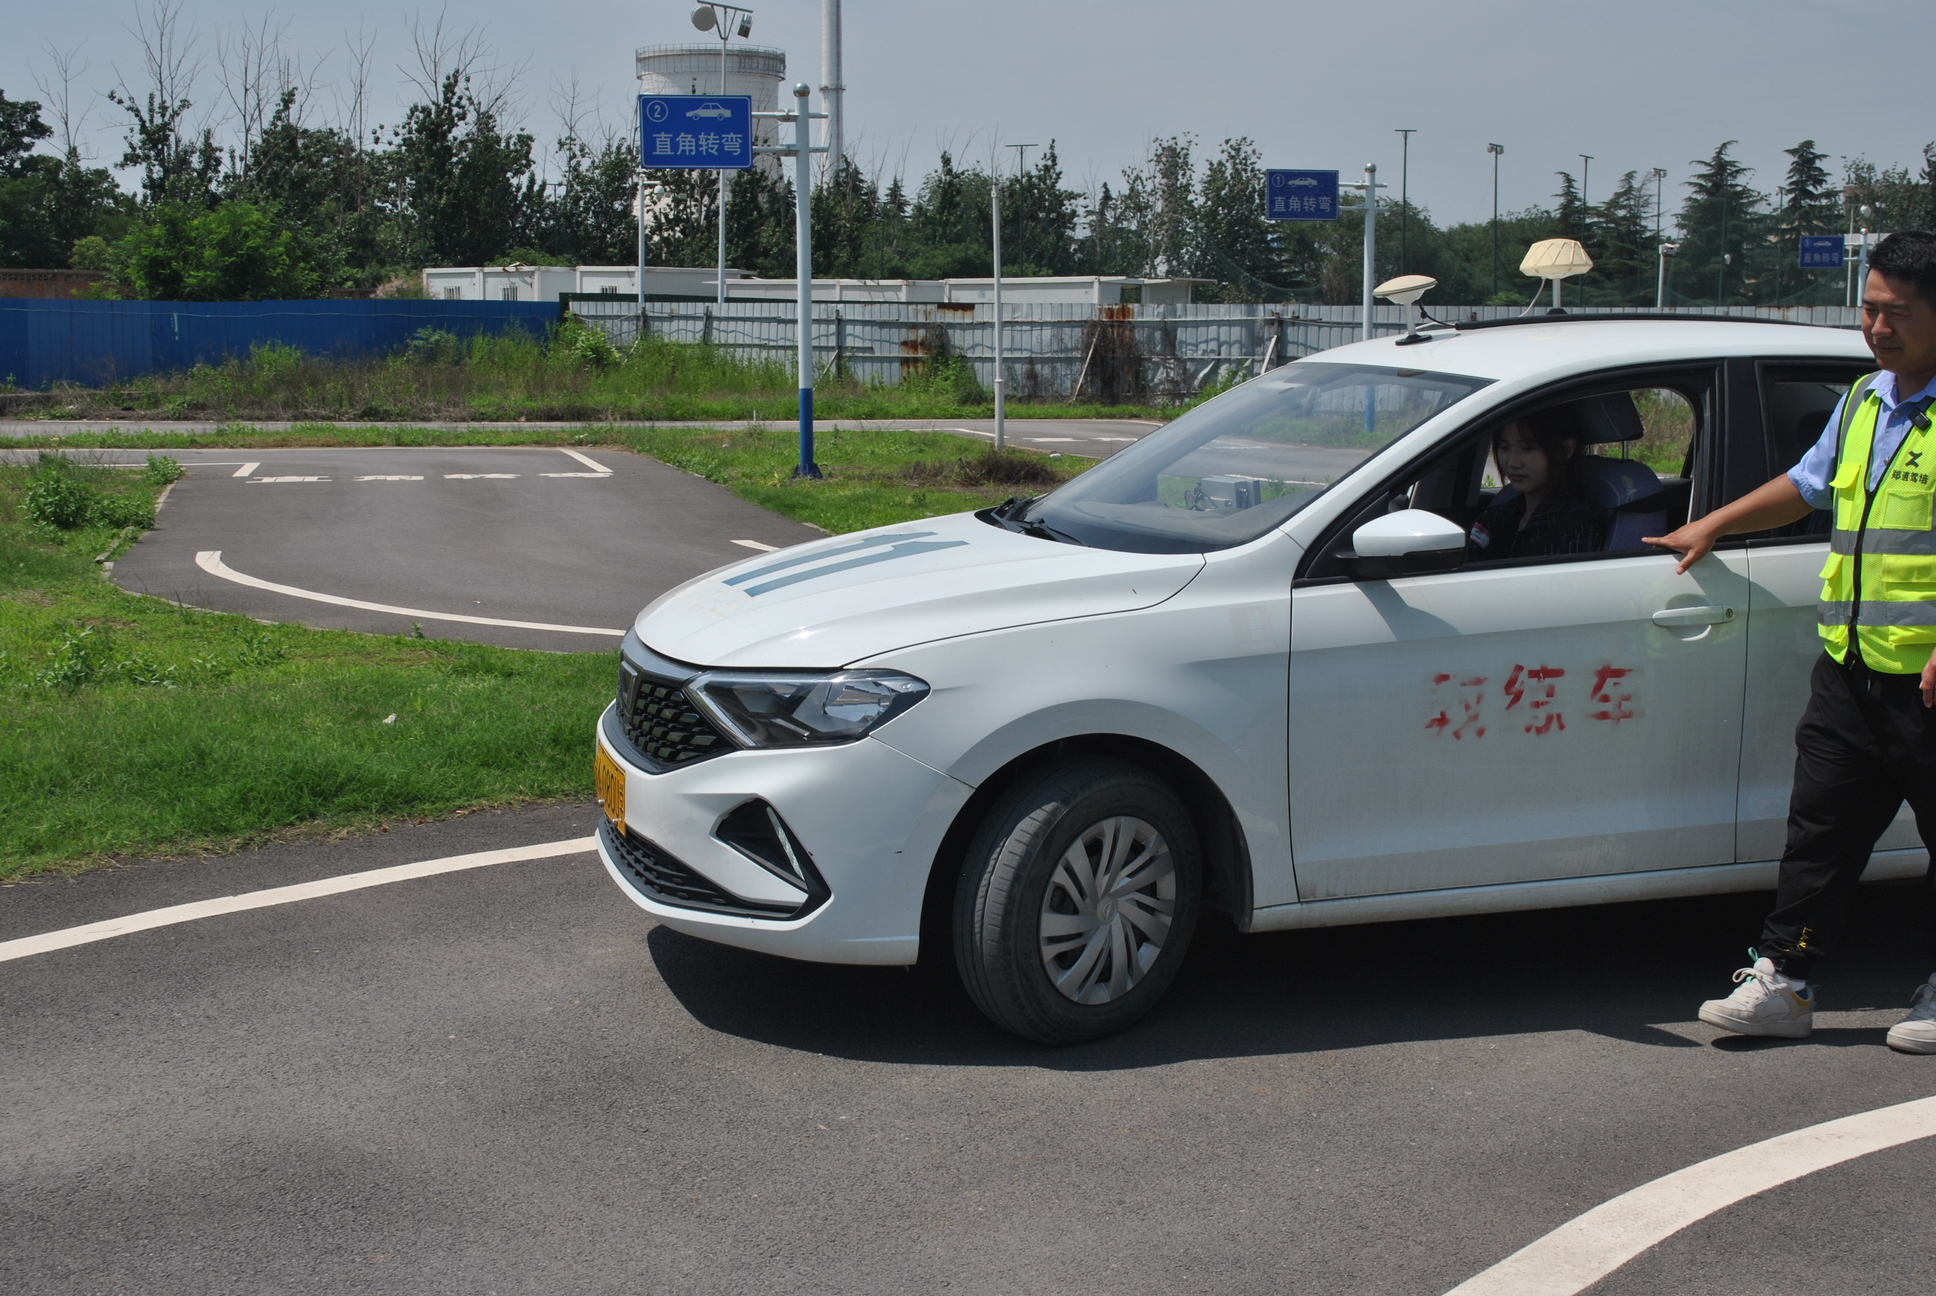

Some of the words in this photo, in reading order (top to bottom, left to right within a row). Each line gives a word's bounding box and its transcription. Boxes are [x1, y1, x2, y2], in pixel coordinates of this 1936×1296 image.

[652, 132, 743, 156] 直角转弯
[1273, 196, 1332, 212] 直角转弯
[1803, 252, 1840, 264] 直角转弯
